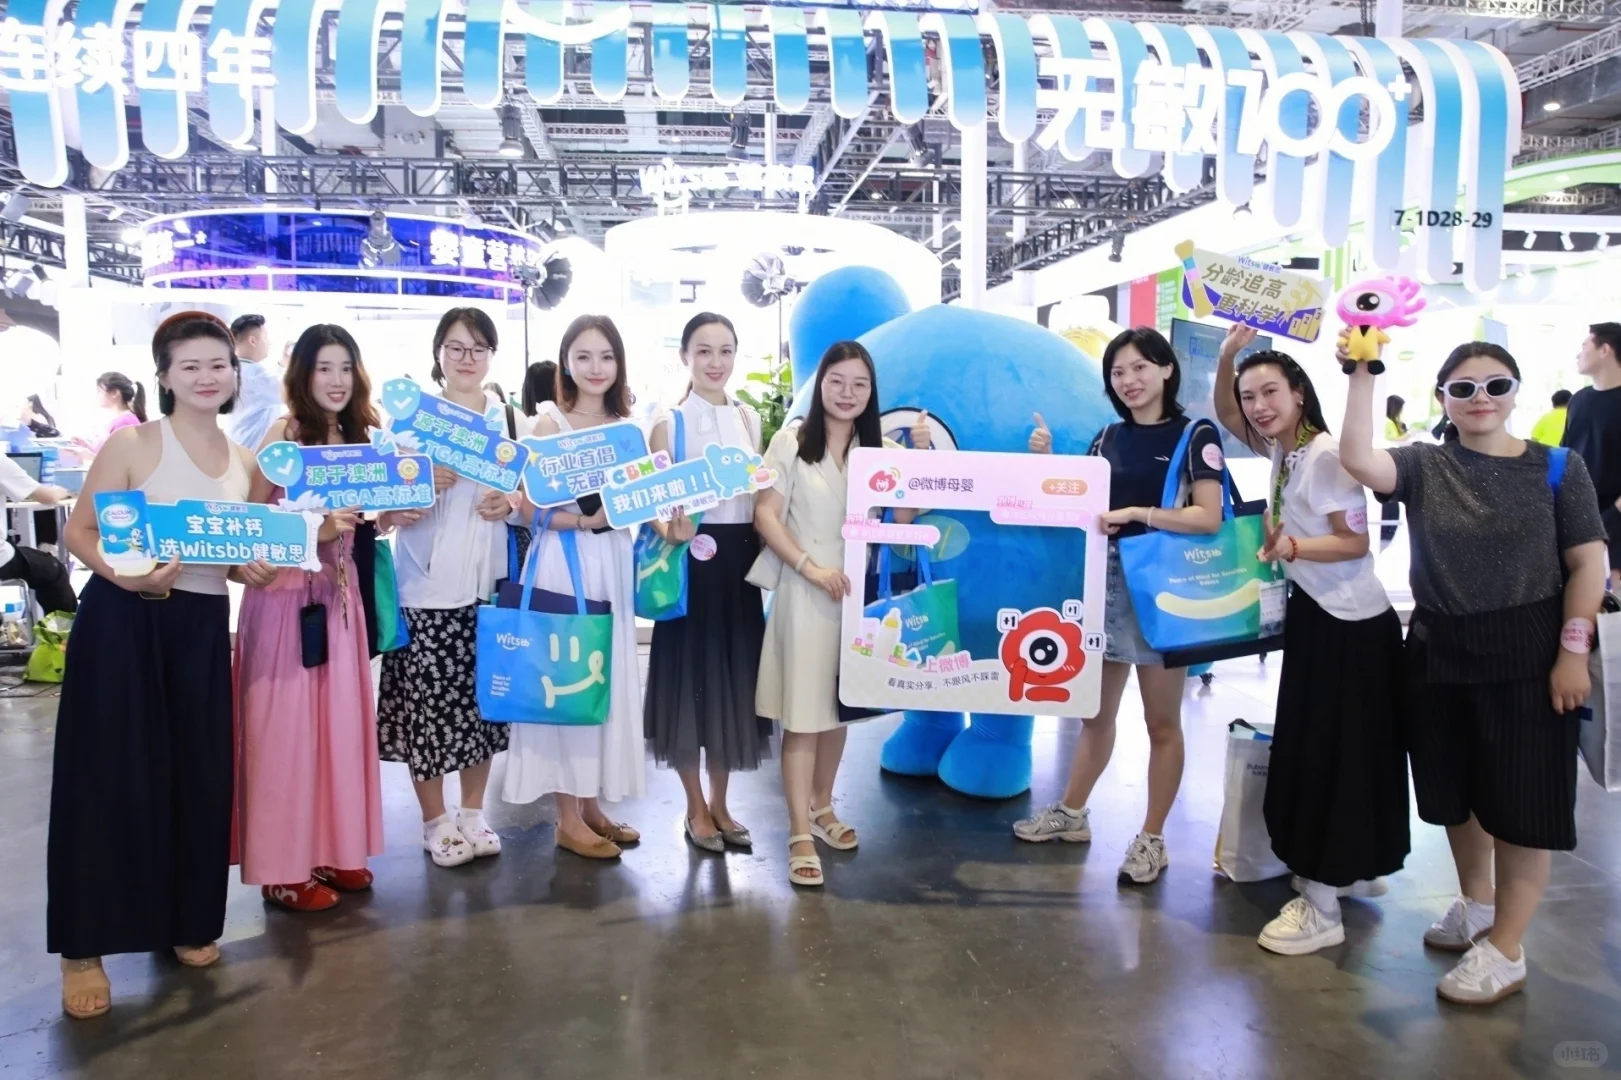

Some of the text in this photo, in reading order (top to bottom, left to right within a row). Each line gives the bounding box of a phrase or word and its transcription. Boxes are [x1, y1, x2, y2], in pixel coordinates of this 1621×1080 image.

[1394, 209, 1493, 228] 7-1D28-29
[1202, 262, 1287, 299] 分龄追高
[1216, 292, 1280, 323] 更科学
[1292, 317, 1298, 328] 1
[1303, 313, 1310, 325] 2
[413, 410, 488, 454] 源于澳洲
[425, 440, 517, 489] TGA高标准
[539, 445, 616, 476] 行业首倡
[306, 463, 387, 485] 源于澳洲
[908, 477, 974, 493] @微博母婴
[1049, 482, 1080, 494] +关注
[328, 484, 432, 507] TGA高标准
[186, 514, 263, 537] 宝宝补钙
[159, 538, 306, 563] 选Witsbb健敏思
[1065, 605, 1077, 615] +1
[1003, 616, 1016, 628] +1
[1088, 637, 1100, 648] +1
[923, 654, 970, 673] 上微博
